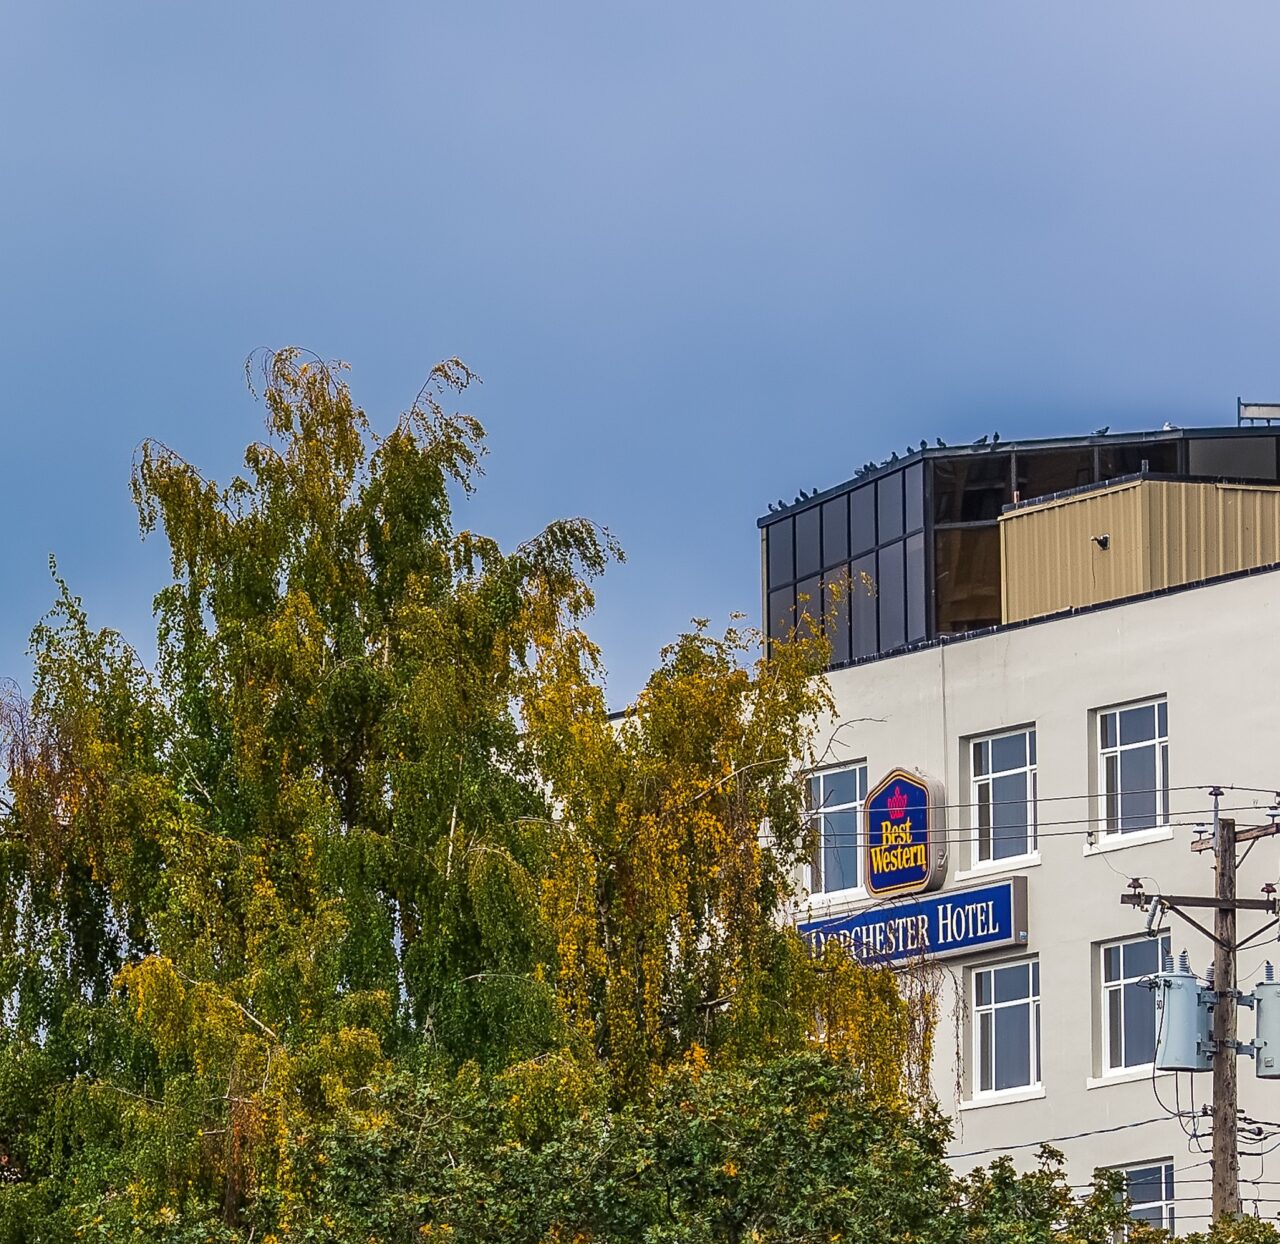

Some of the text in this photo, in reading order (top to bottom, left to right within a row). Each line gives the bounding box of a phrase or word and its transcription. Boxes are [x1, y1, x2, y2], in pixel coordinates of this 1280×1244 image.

[881, 817, 913, 847] Best
[871, 843, 926, 874] Western
[811, 901, 999, 961] DRCHESTER HOTEL
